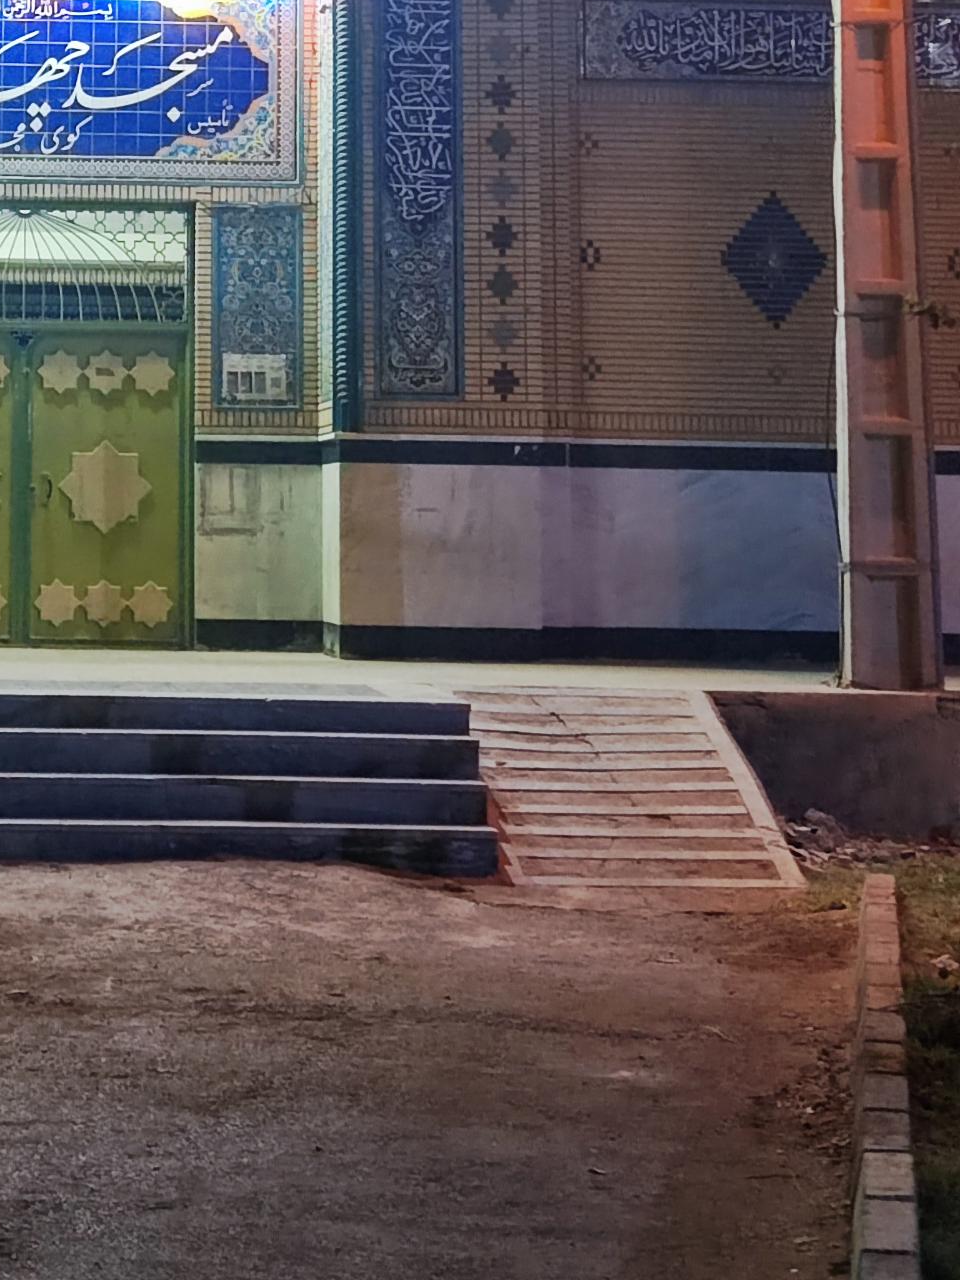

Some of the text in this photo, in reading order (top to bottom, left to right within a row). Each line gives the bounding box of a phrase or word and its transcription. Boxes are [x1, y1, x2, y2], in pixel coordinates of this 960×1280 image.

[57, 3, 113, 20] بسم
[62, 26, 234, 122] مسجد
[40, 116, 94, 155] کوی
